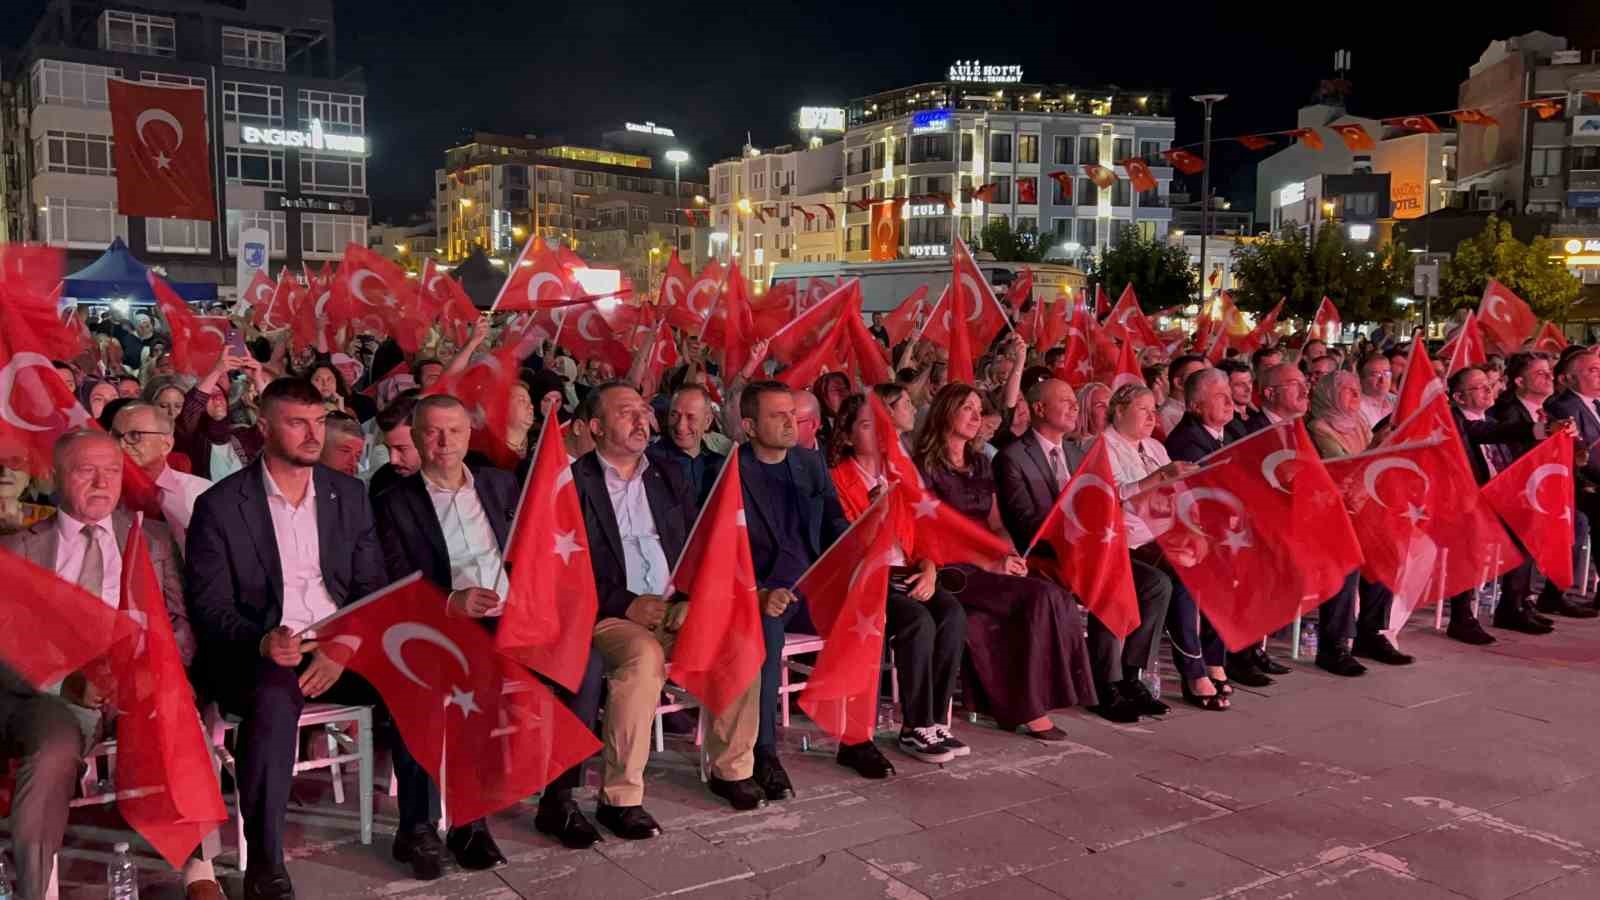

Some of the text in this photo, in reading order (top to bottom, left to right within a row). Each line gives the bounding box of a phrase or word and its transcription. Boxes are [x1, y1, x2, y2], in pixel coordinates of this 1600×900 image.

[983, 65, 1024, 77] HOTEL
[912, 204, 945, 216] KULE
[909, 245, 947, 257] HOTEL
